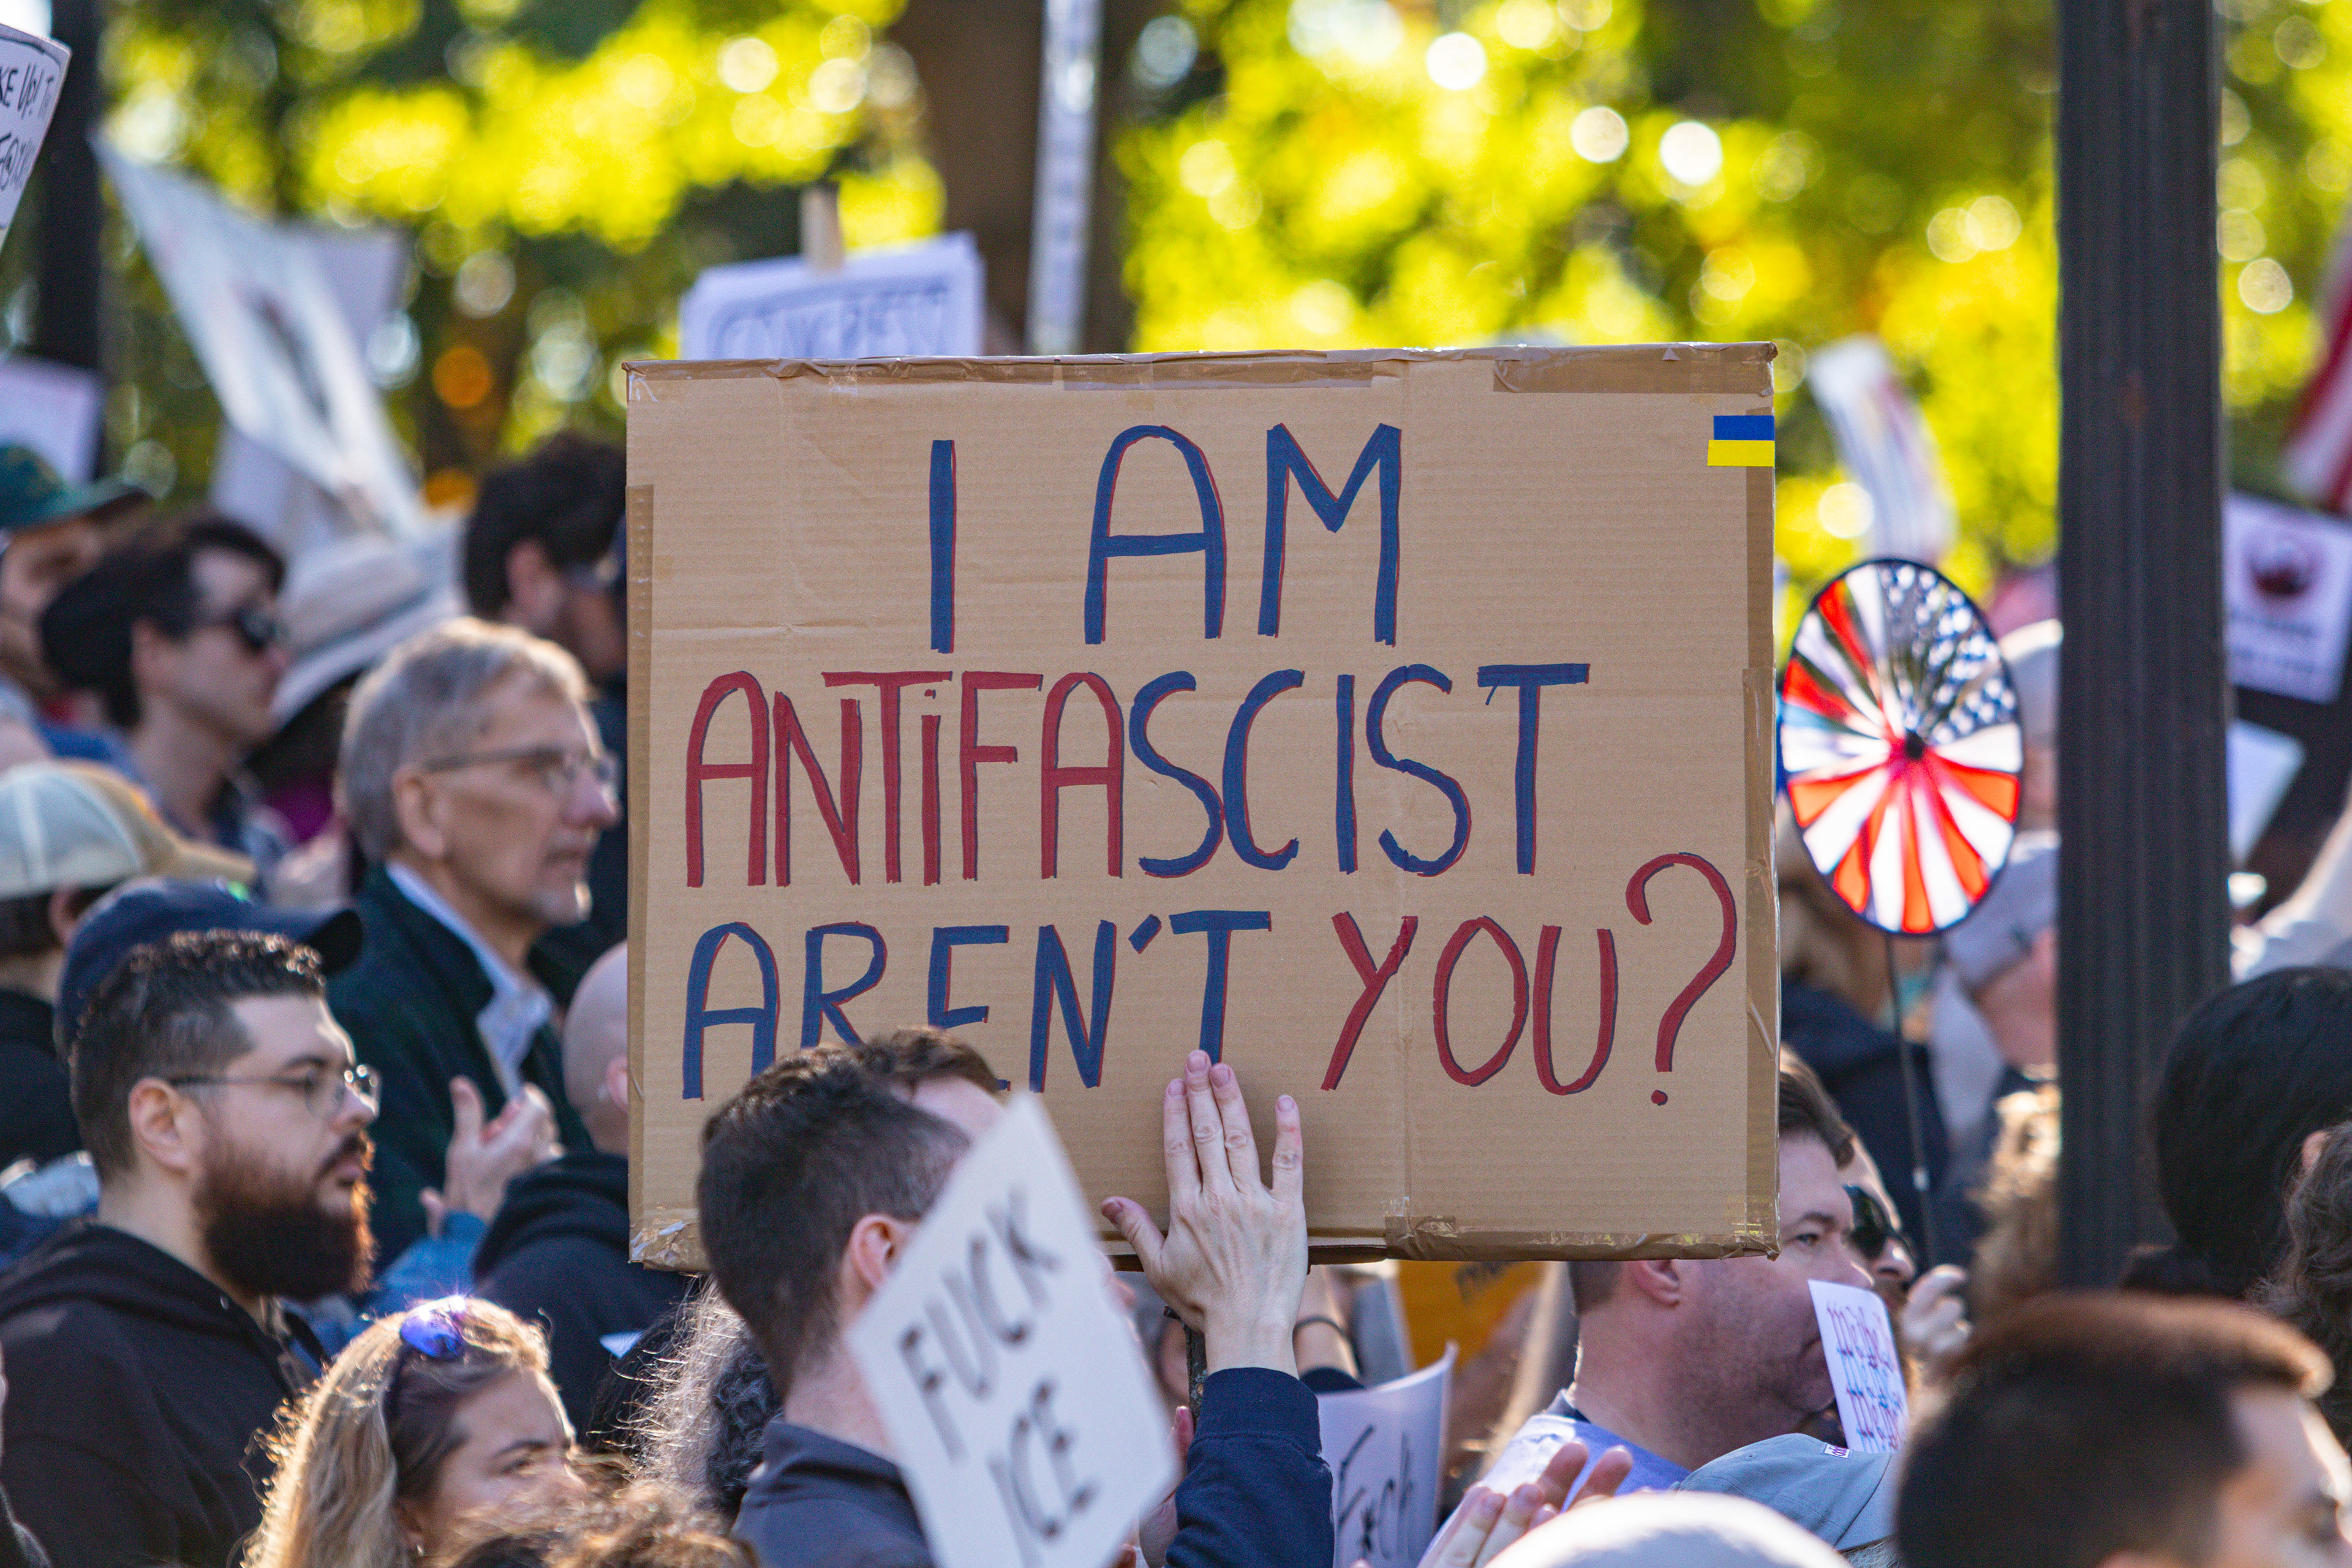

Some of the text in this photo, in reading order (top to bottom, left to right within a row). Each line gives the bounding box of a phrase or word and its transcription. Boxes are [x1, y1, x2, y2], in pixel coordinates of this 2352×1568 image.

[929, 423, 1402, 654] I AM
[1321, 852, 1738, 1106] YOU?
[897, 1183, 1066, 1466] FUCK
[986, 1377, 1101, 1568] ICE
